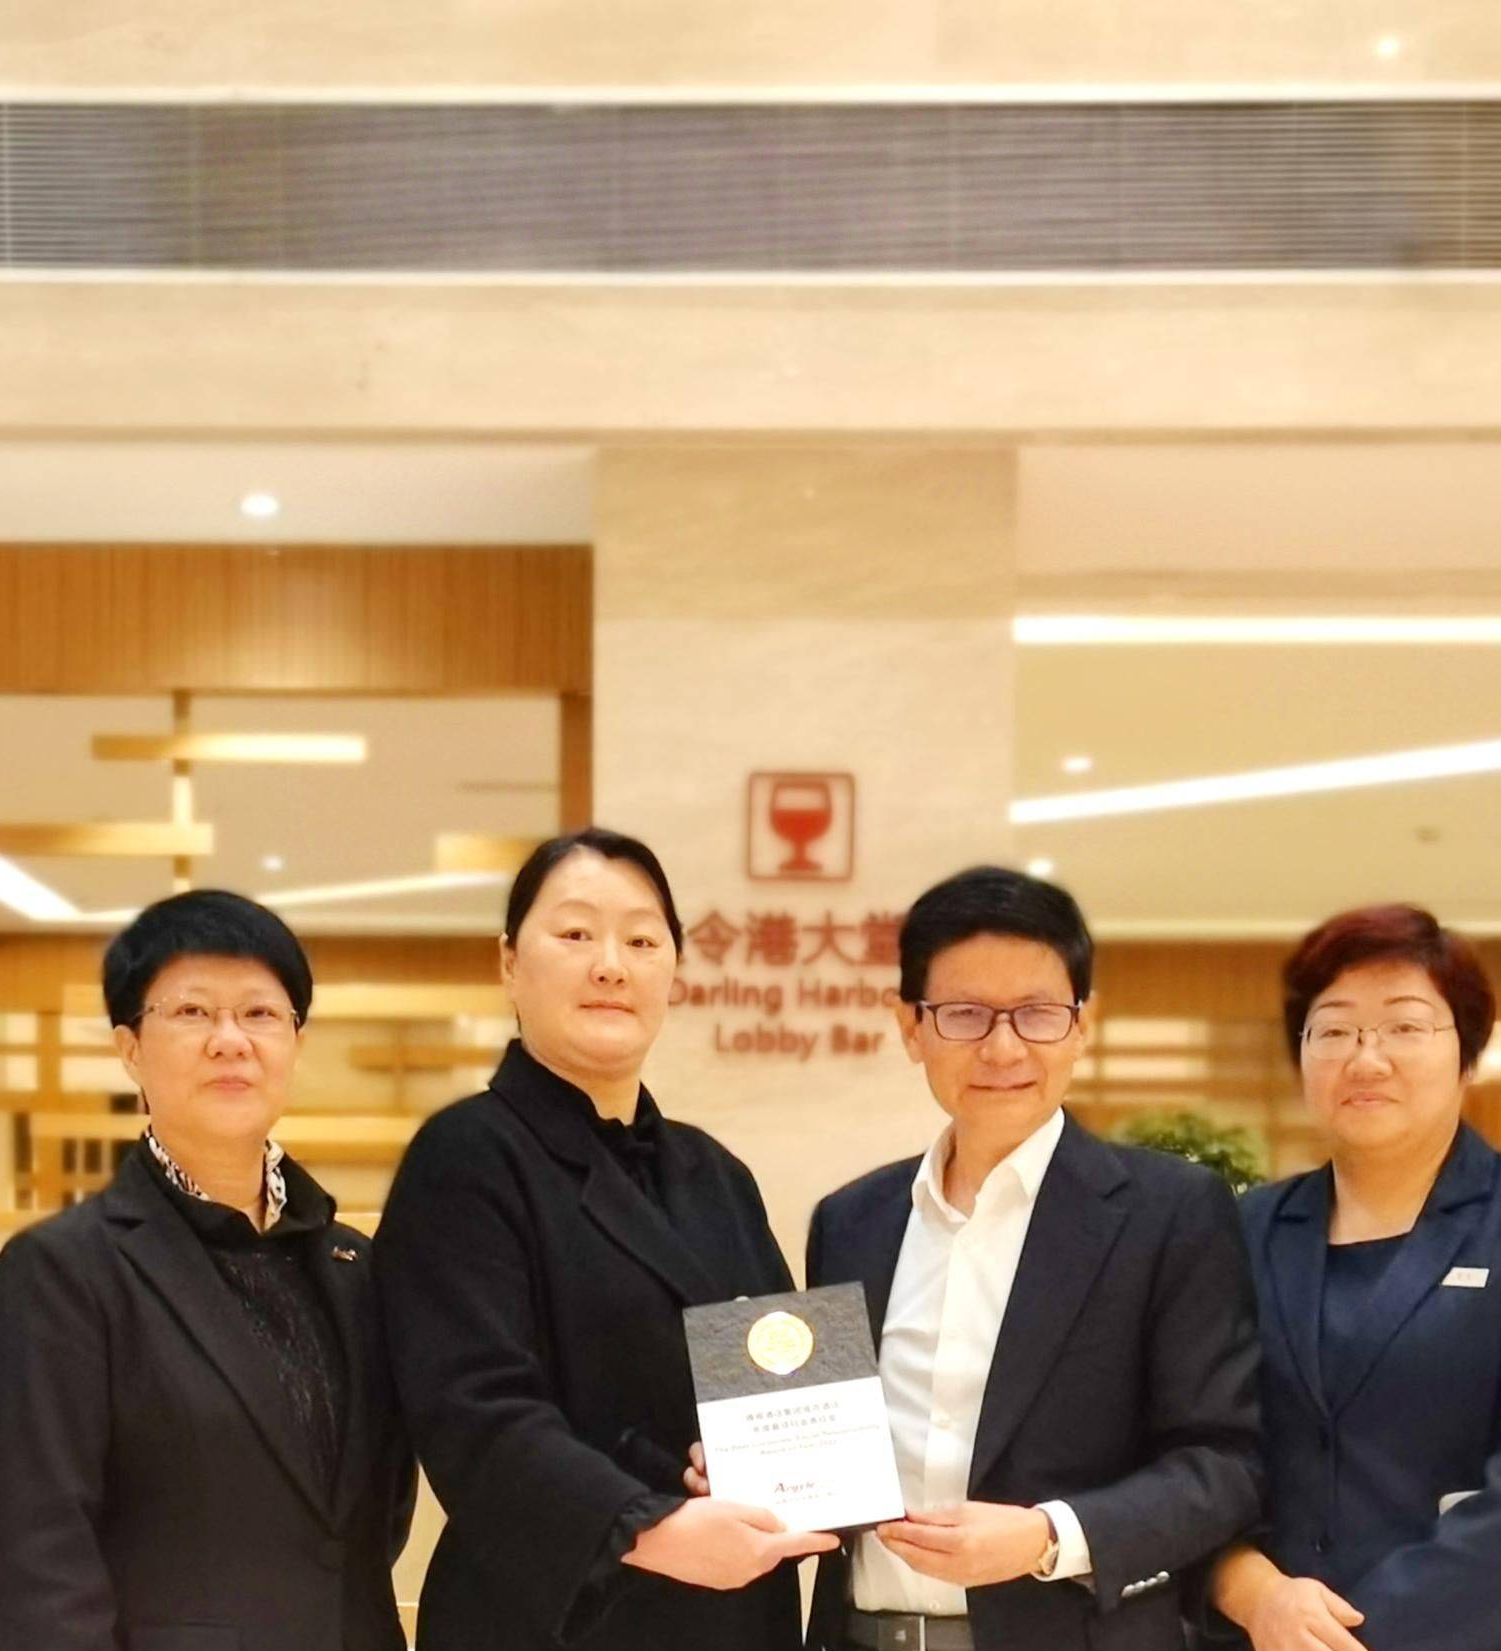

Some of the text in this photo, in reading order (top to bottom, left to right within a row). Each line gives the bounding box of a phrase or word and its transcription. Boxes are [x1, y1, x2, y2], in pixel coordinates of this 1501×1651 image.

[680, 910, 903, 966] 令港大堂
[670, 977, 784, 1016] Darling
[715, 1022, 886, 1062] Lobby Bar
